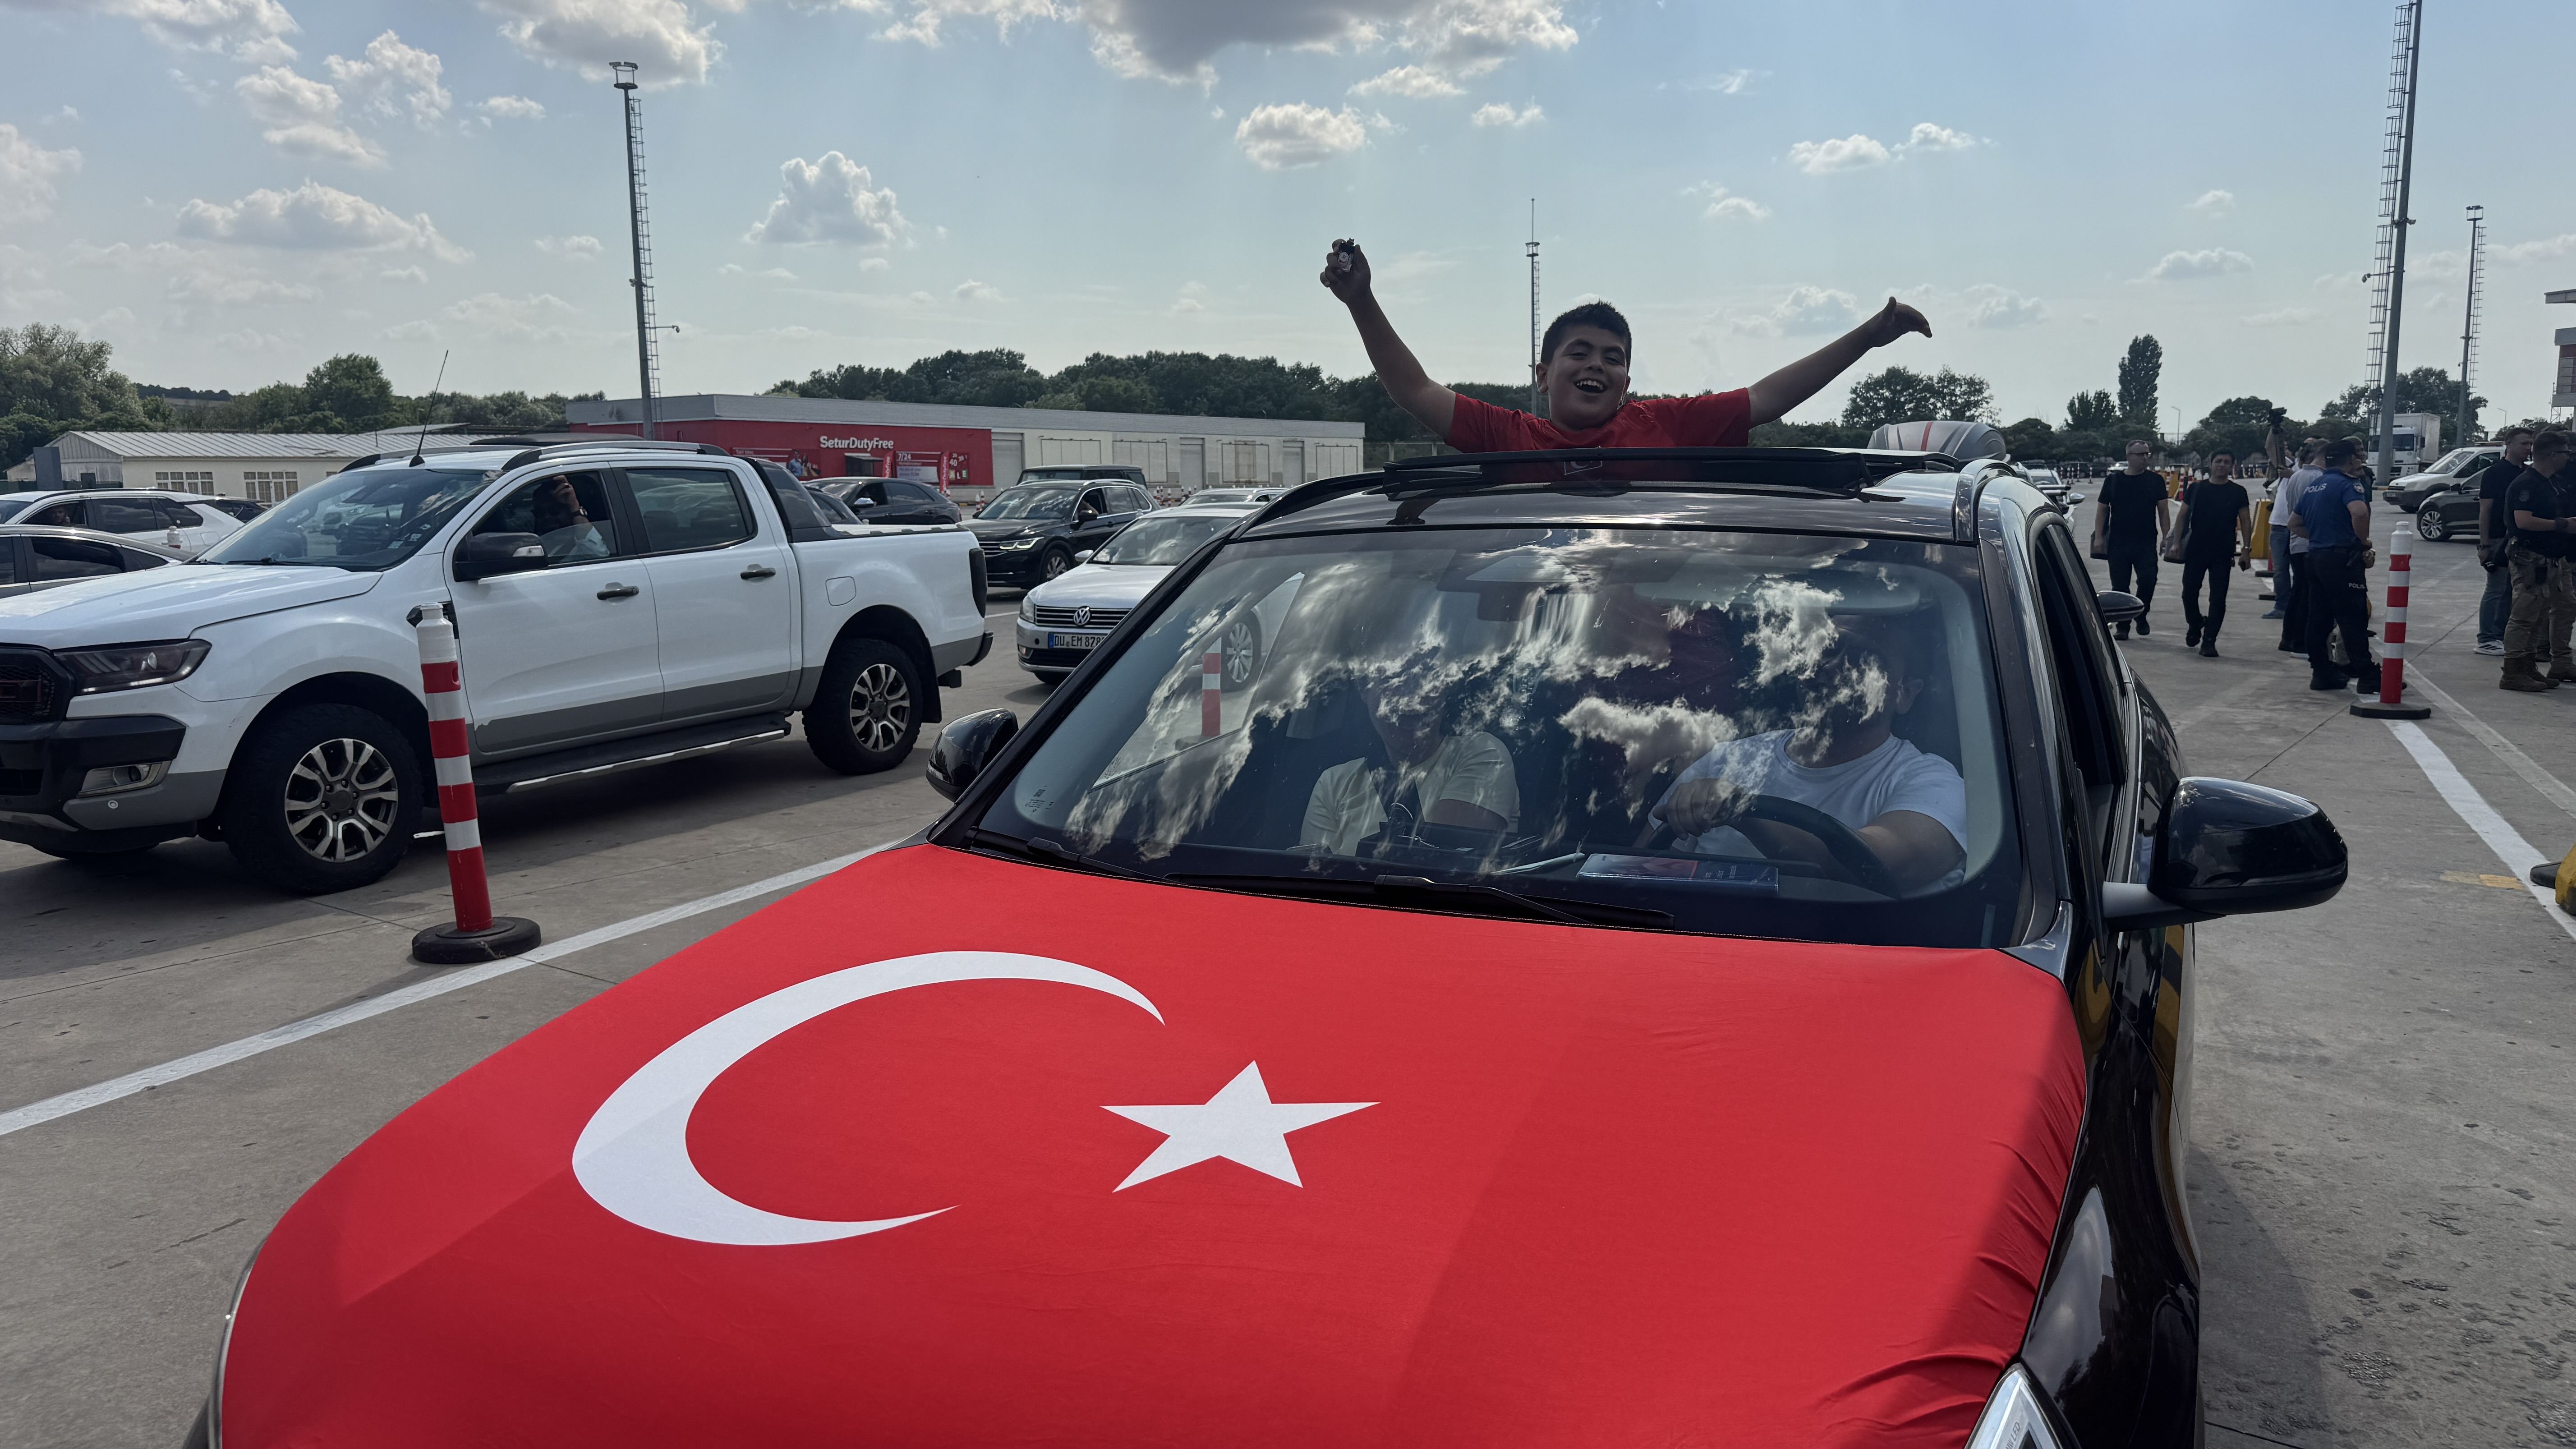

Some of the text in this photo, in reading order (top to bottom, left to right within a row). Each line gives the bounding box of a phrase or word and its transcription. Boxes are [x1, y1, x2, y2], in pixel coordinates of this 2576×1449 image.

[820, 436, 894, 451] SeturDutyFree
[898, 452, 911, 461] 7/24
[949, 459, 958, 467] 40
[1054, 635, 1105, 648] DU EM 878
[2010, 1421, 2020, 1442] LED
